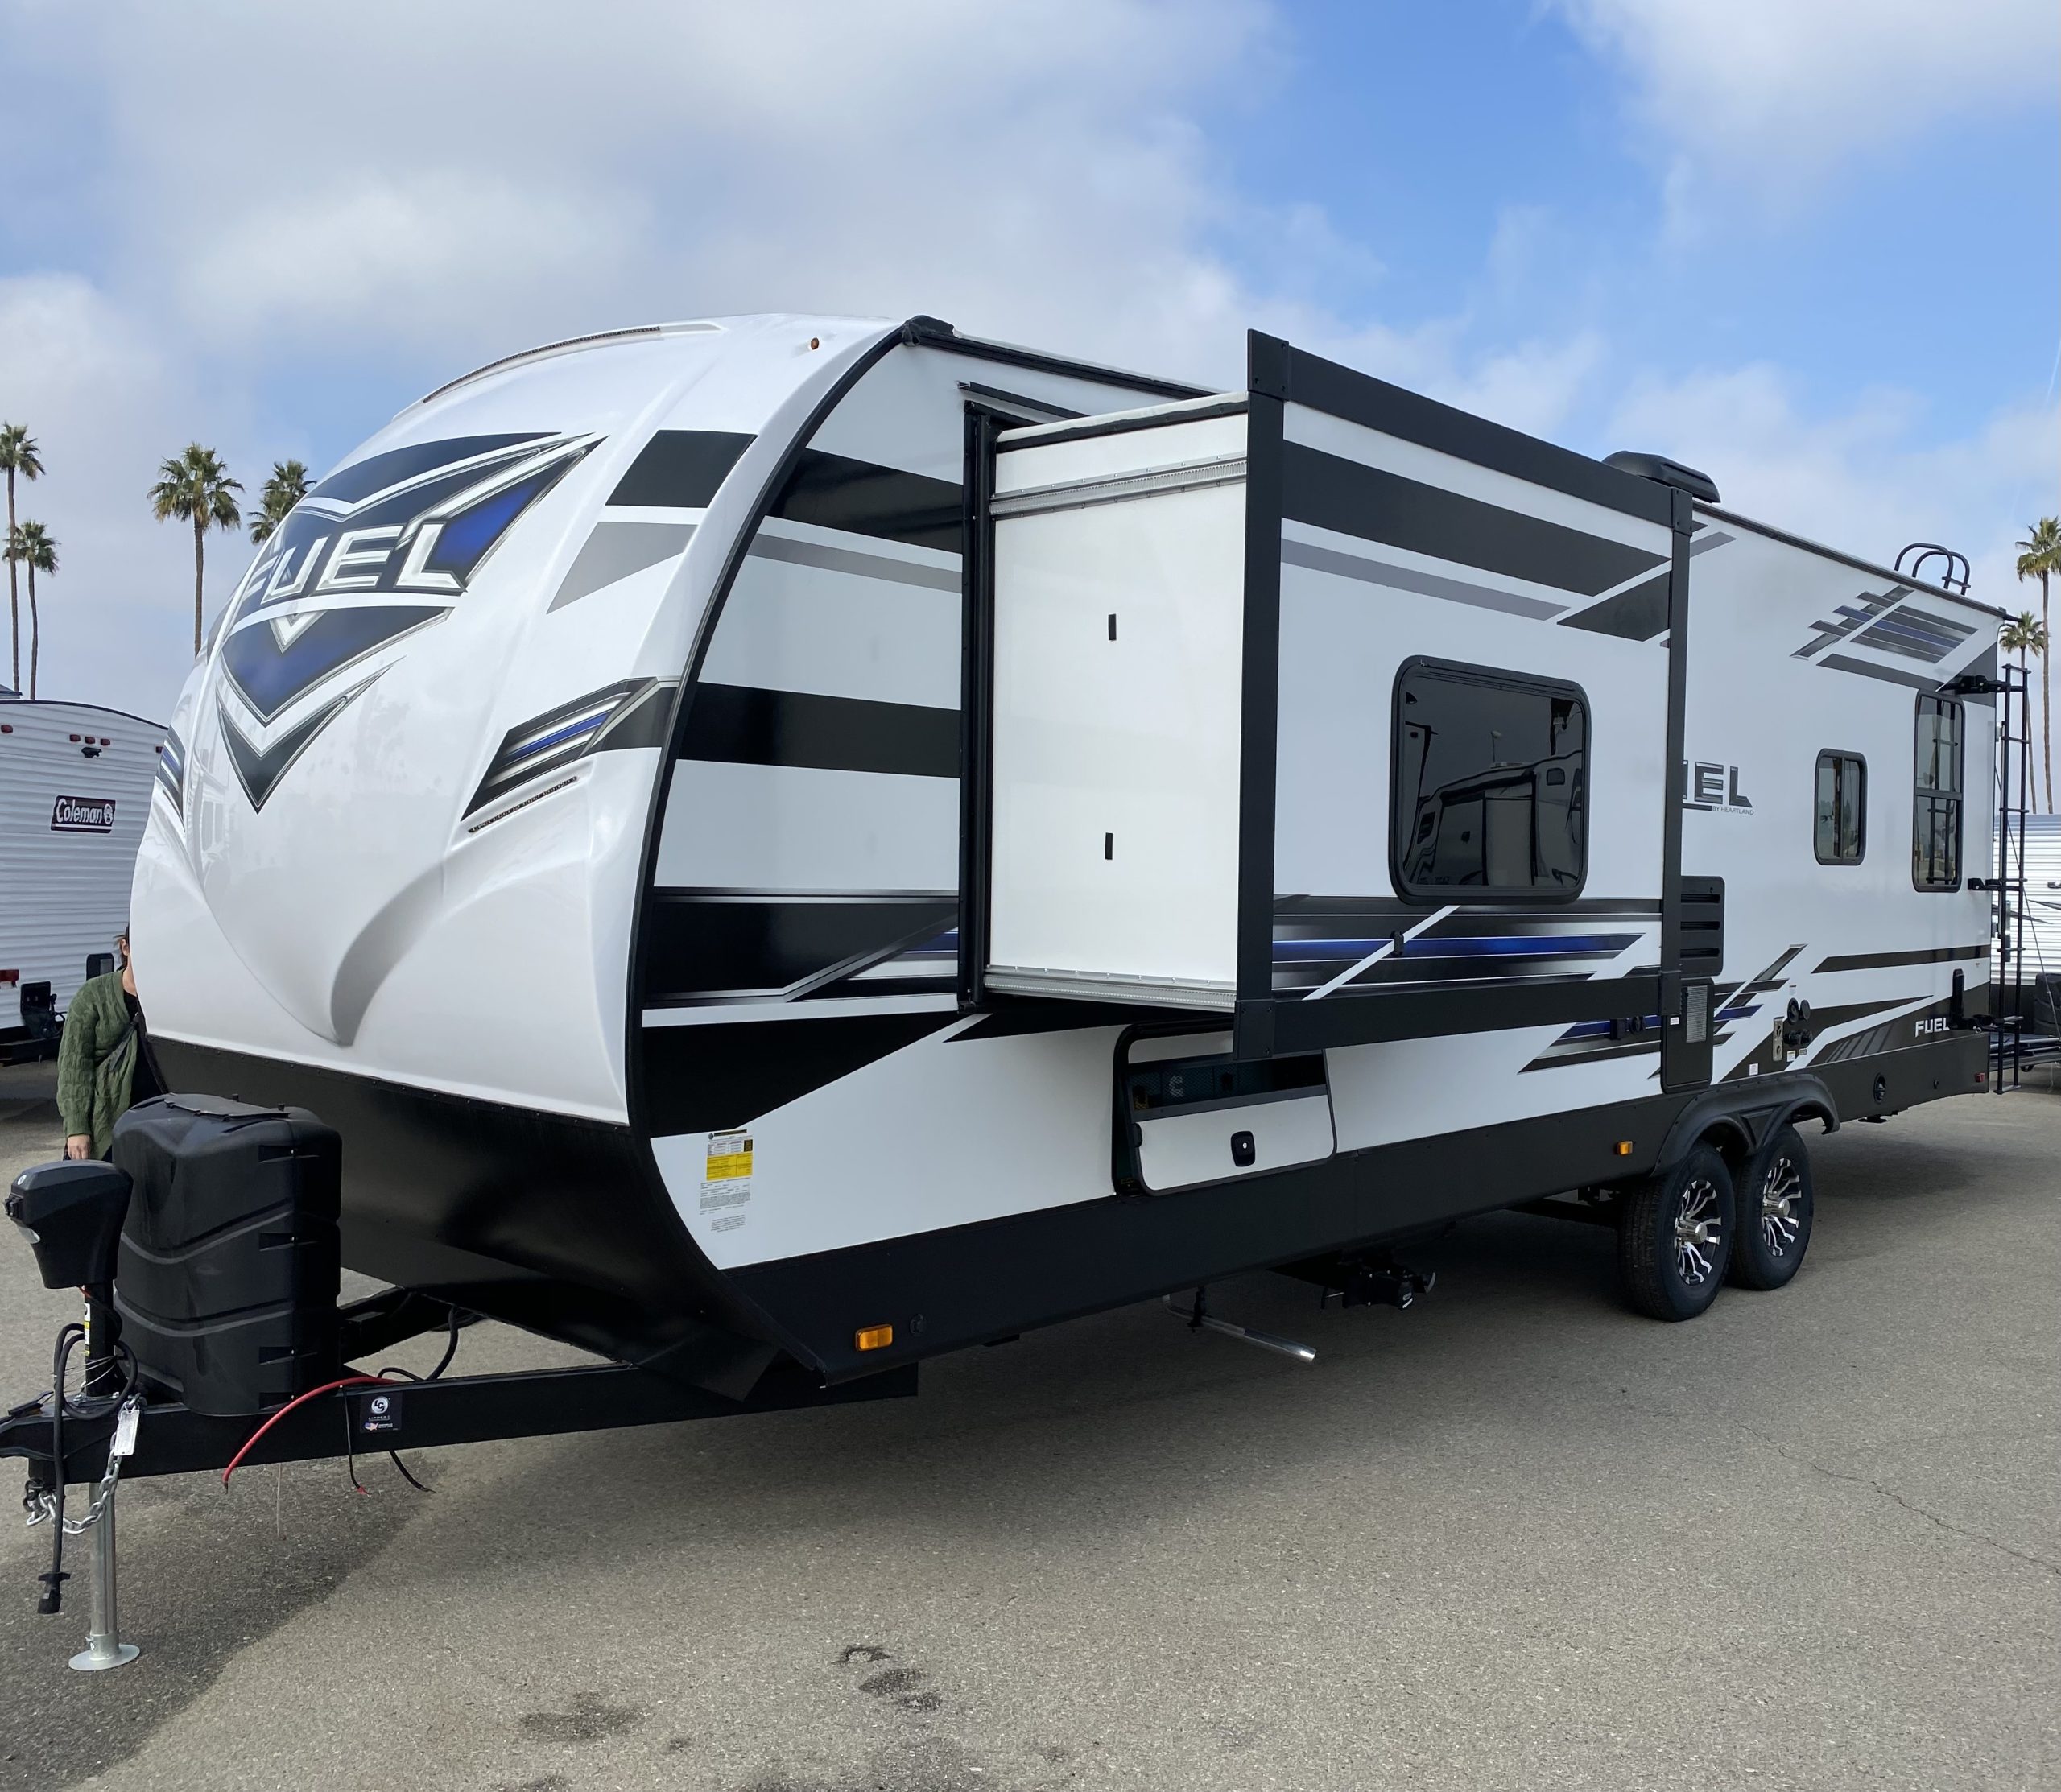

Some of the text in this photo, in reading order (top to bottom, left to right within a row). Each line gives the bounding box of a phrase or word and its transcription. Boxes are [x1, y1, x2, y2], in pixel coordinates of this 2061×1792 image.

[241, 521, 466, 605] FUEL
[1683, 760, 1753, 807] EL
[56, 798, 103, 824] Coleman
[1720, 807, 1754, 815] HEARTLAND
[1915, 1017, 1950, 1038] FUEL
